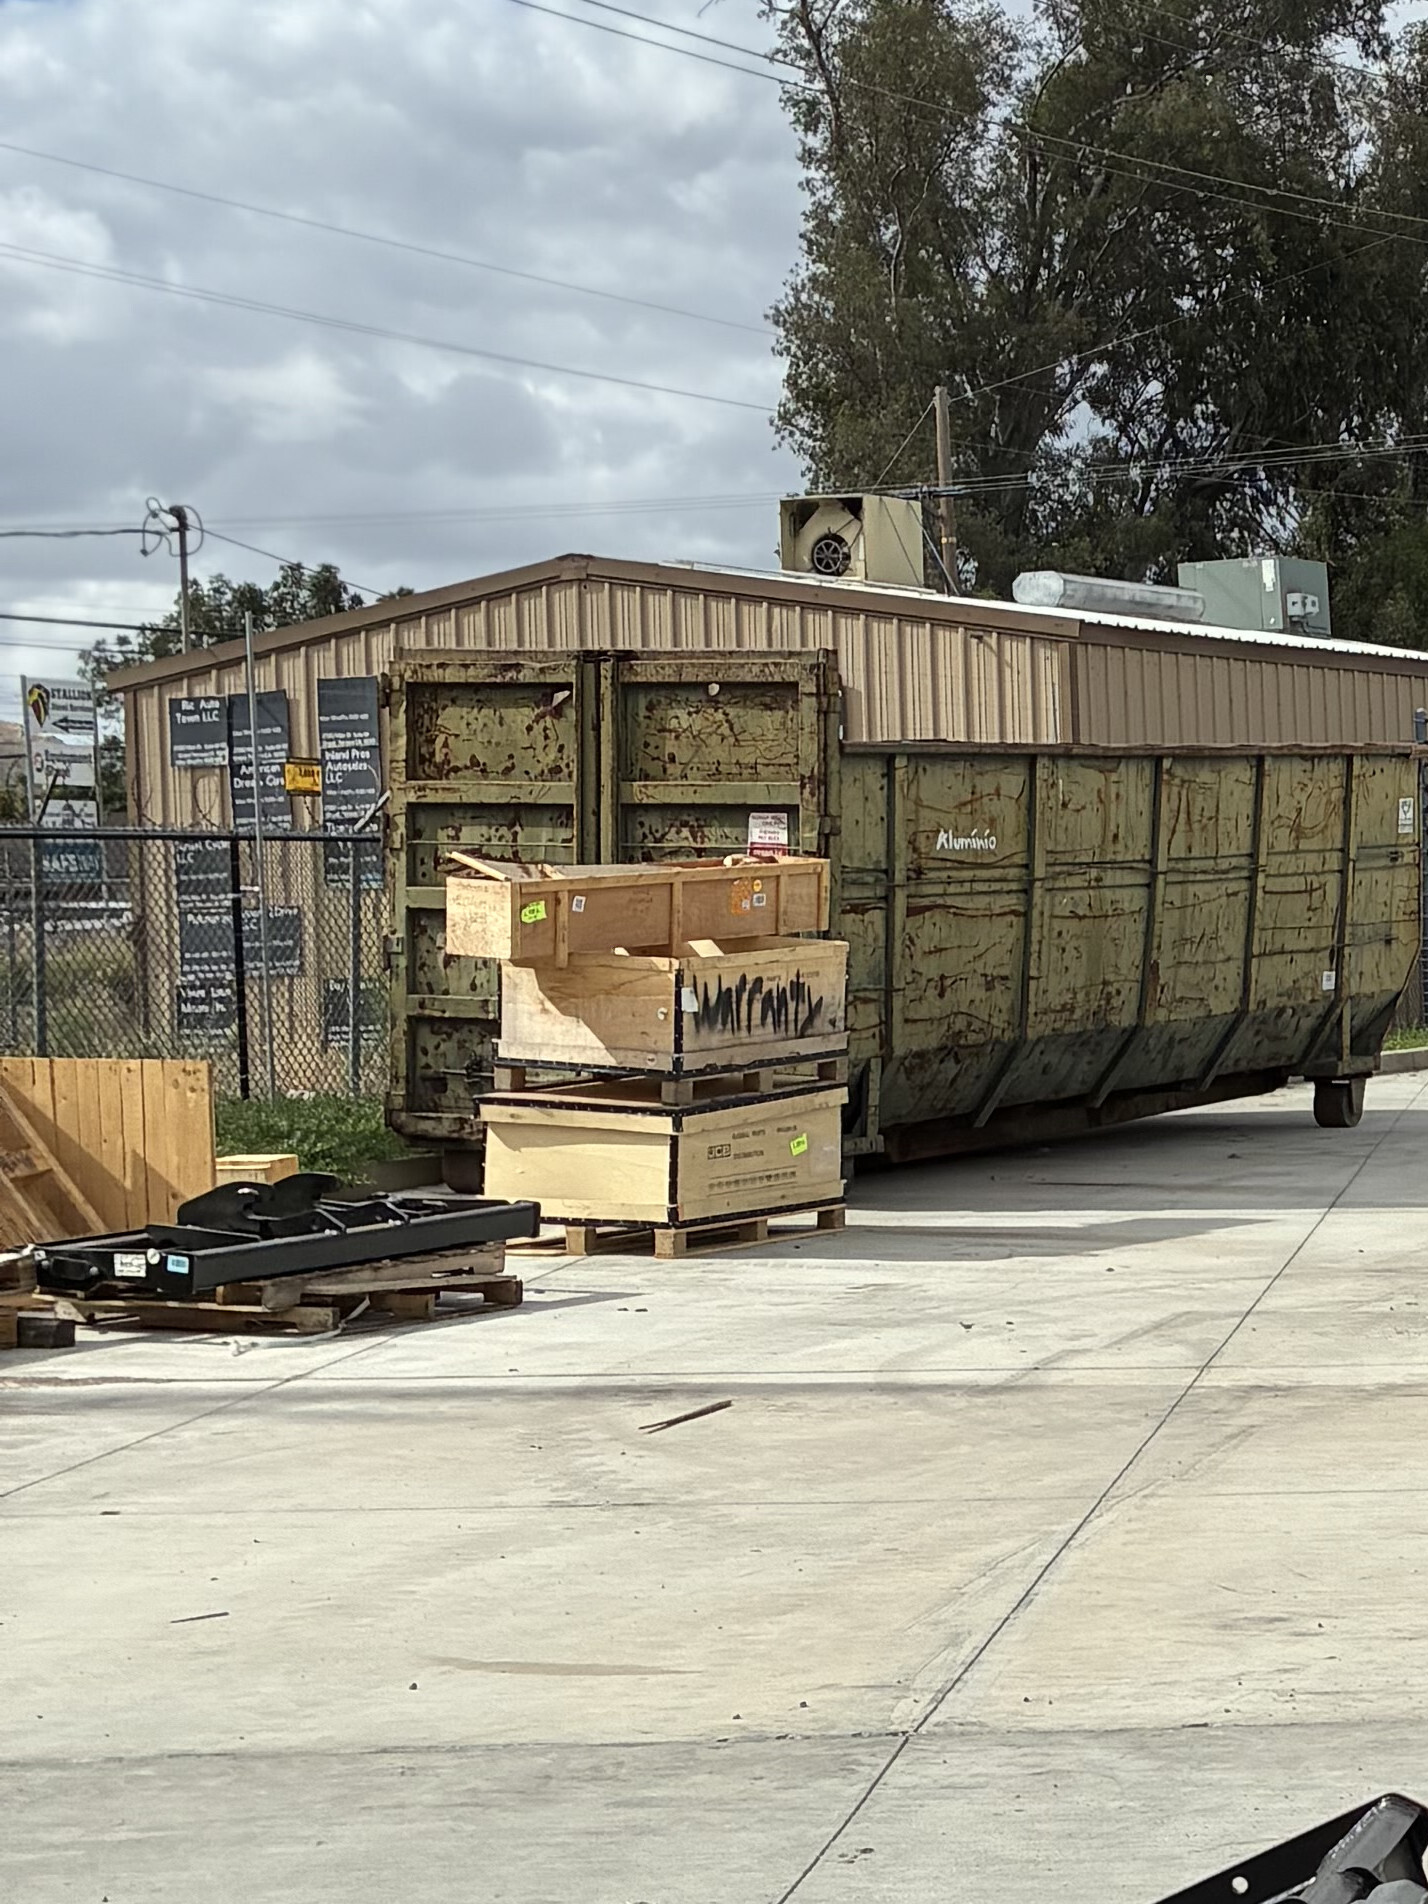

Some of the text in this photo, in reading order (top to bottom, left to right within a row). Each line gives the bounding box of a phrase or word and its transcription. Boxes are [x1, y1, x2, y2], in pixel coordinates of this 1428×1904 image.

[200, 699, 220, 709] Auto
[175, 710, 220, 724] Town LLC
[325, 771, 343, 784] LLC
[692, 968, 824, 1038] Warranty
[708, 1144, 731, 1159] JCB
